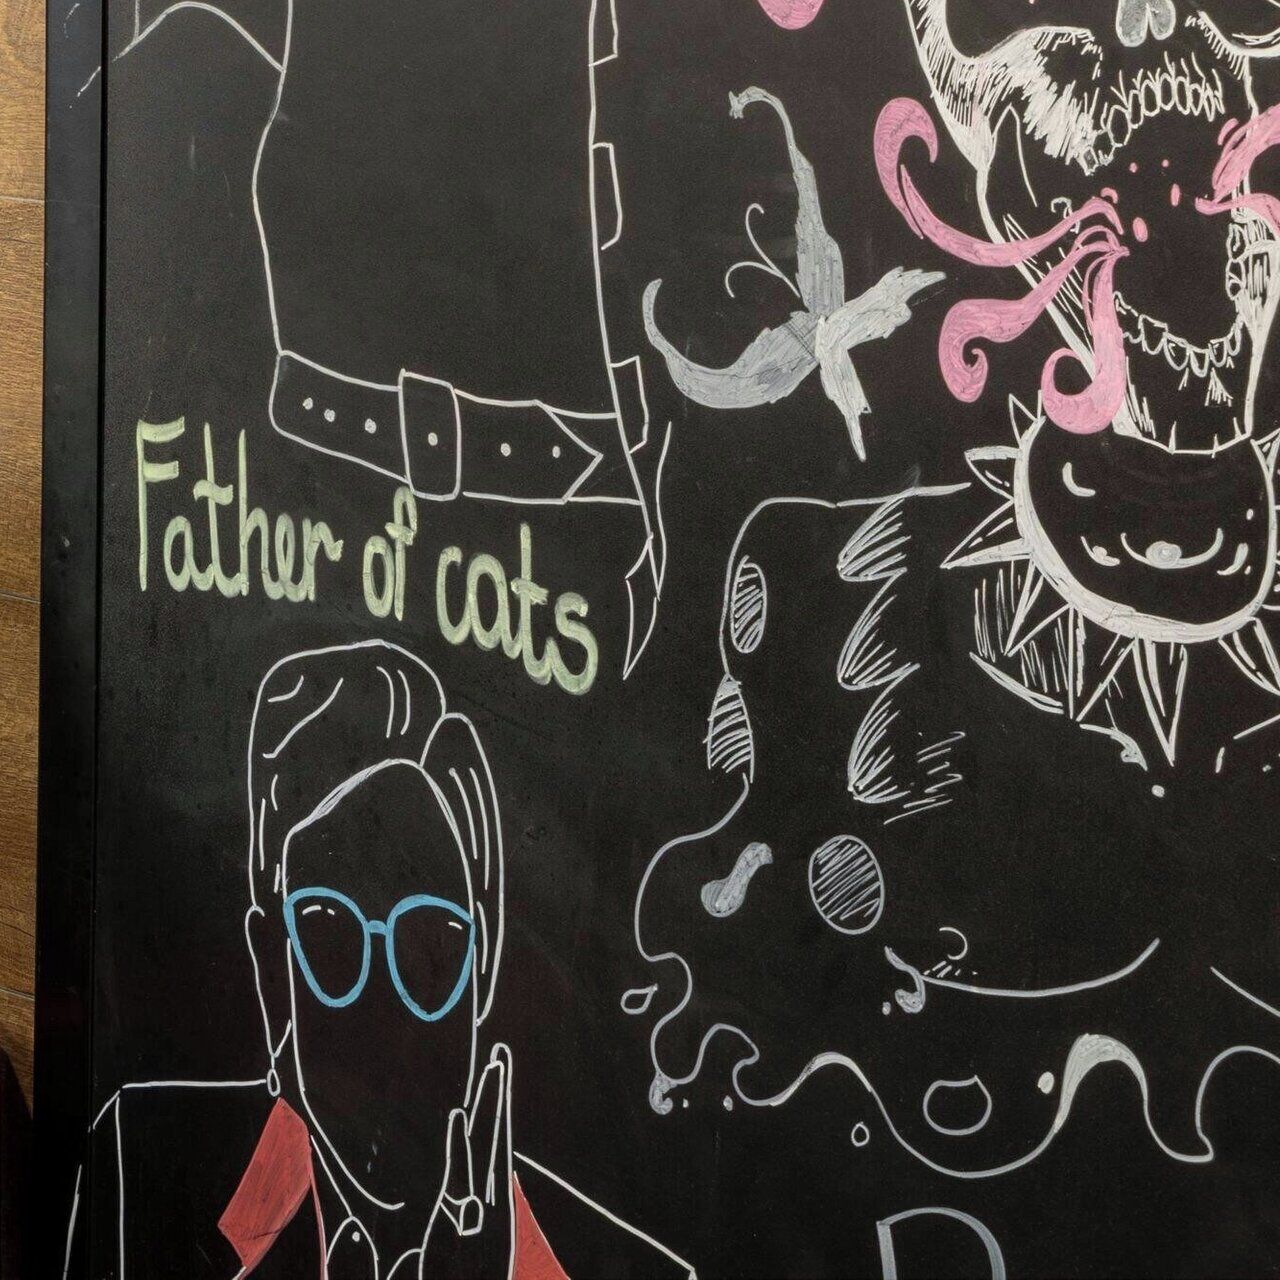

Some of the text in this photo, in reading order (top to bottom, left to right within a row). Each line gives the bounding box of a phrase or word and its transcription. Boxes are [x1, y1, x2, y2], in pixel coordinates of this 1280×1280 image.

[136, 416, 599, 696] Father of cats
